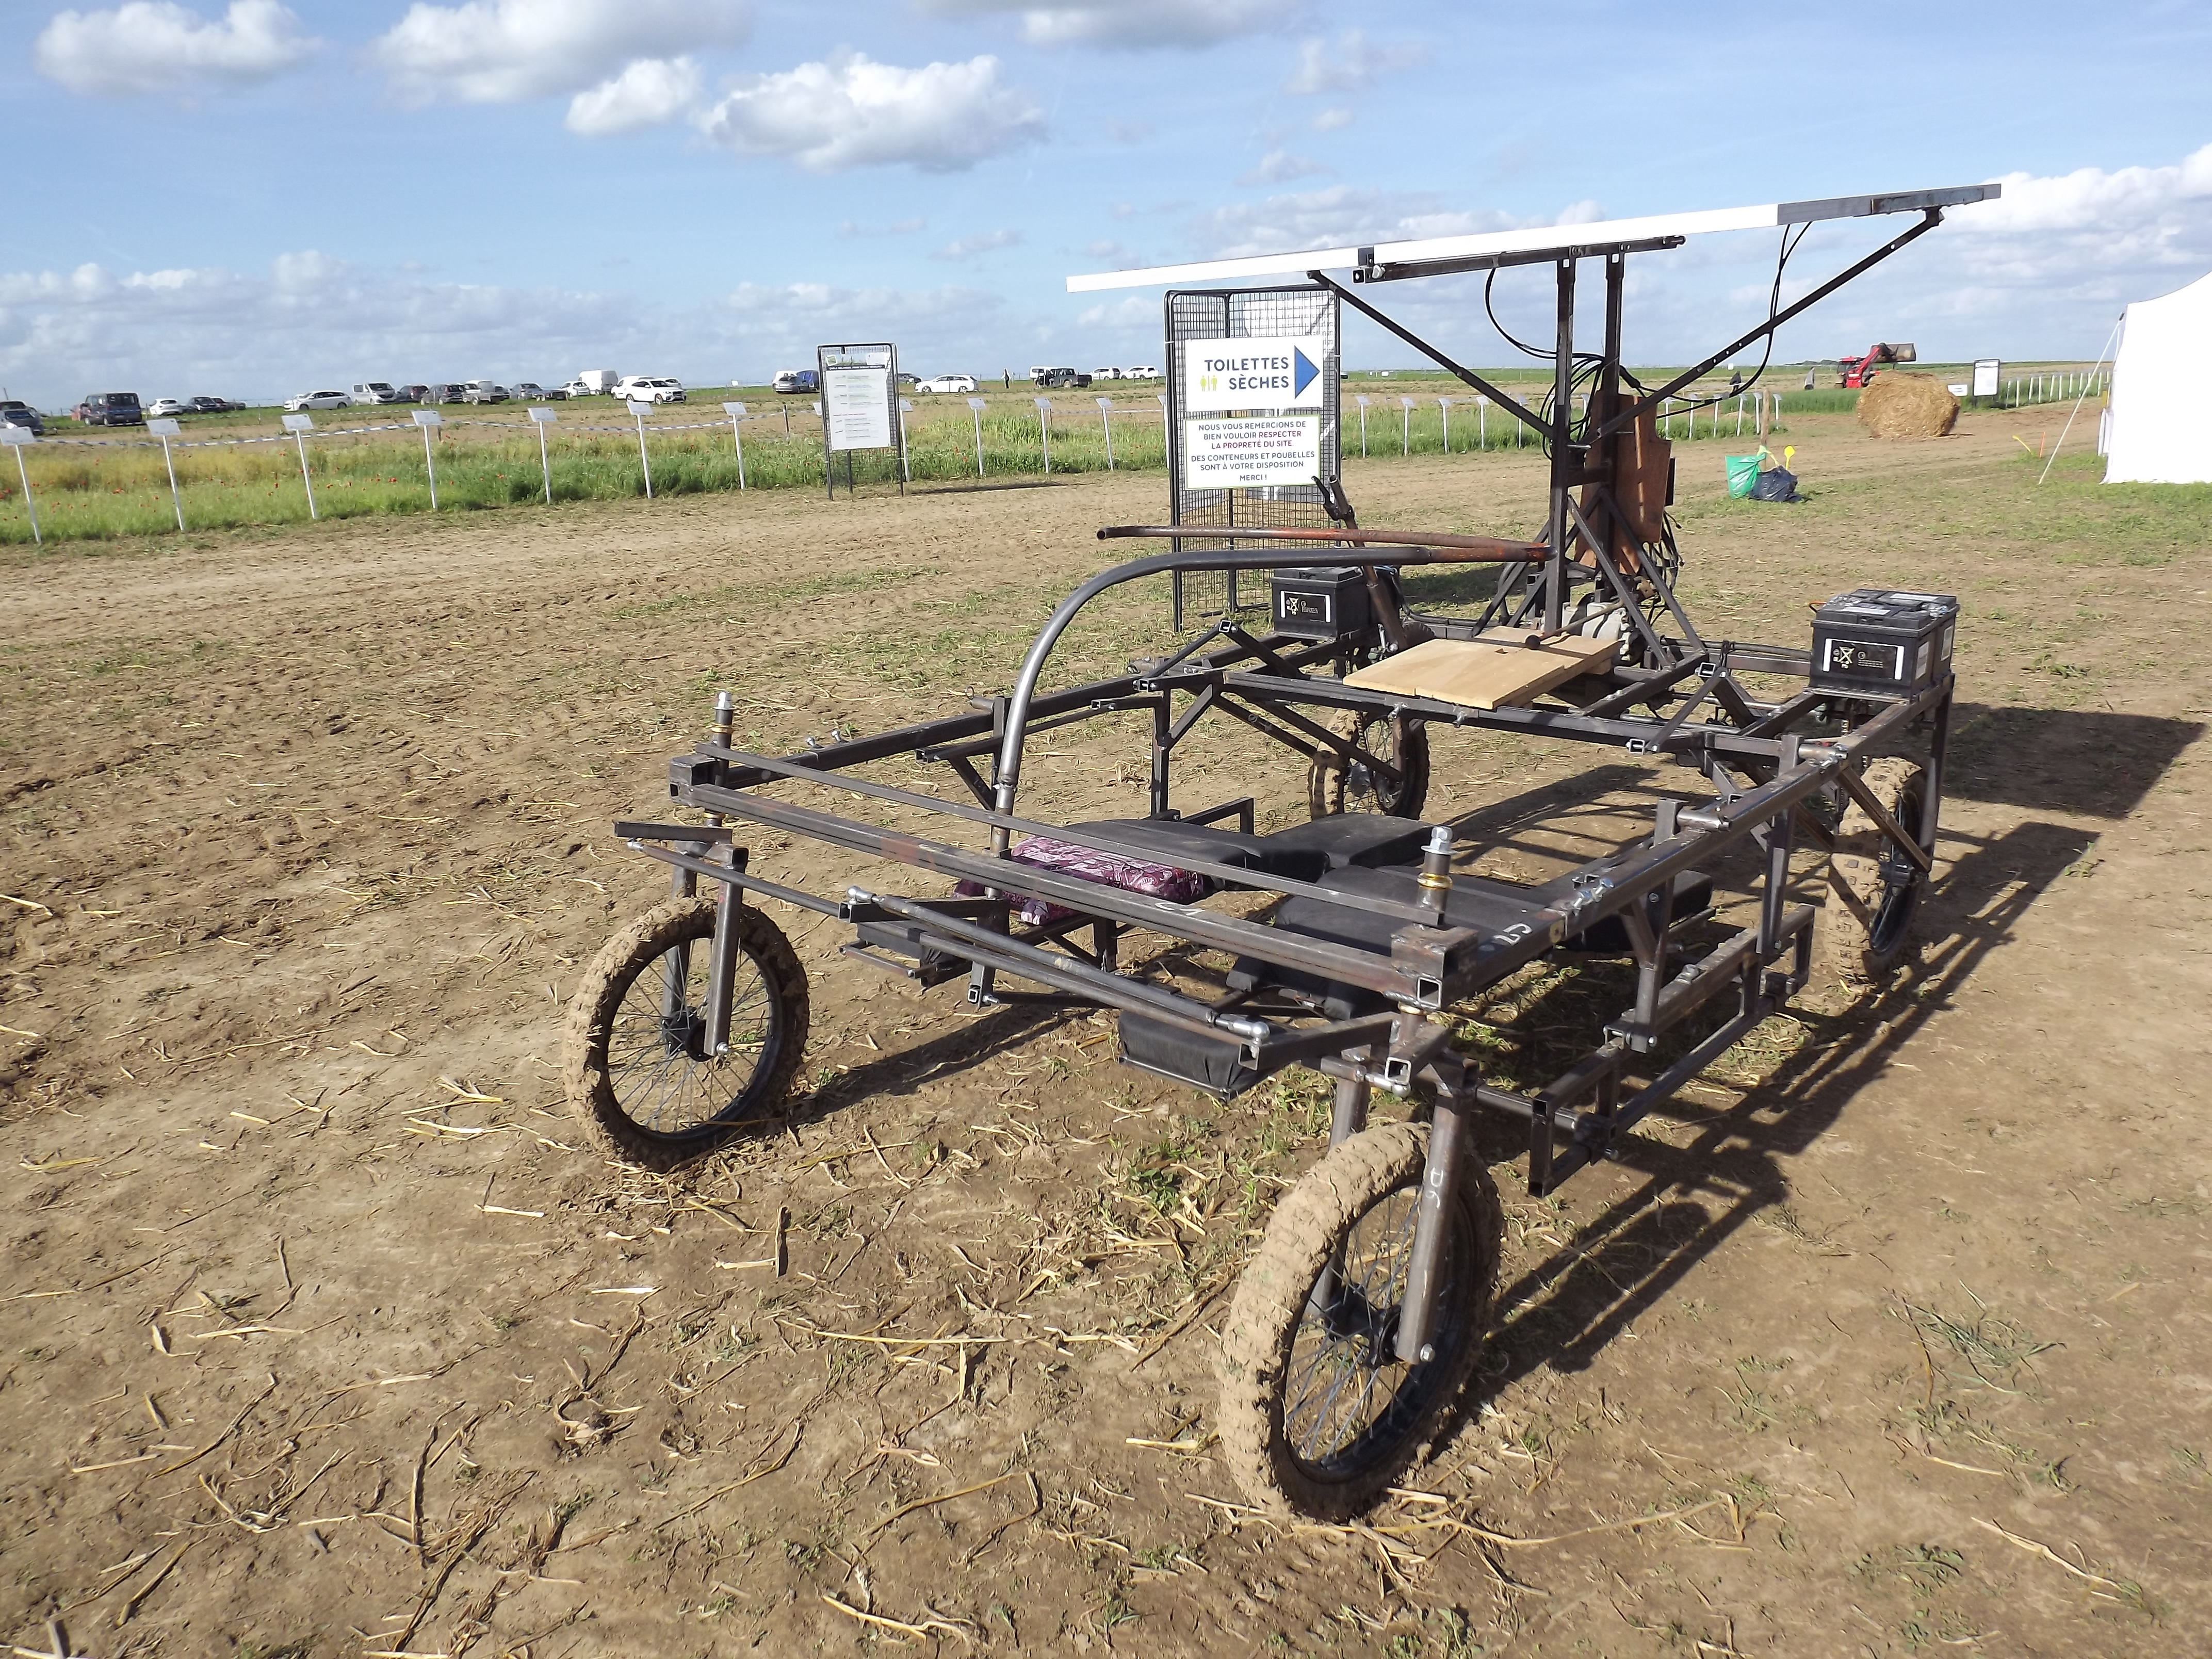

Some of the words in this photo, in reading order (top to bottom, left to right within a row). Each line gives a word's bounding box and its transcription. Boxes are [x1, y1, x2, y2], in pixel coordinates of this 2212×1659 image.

[1204, 357, 1289, 371] TOILETTES
[1229, 373, 1289, 389] SÈCHES
[1245, 421, 1294, 429] REMERCIONS
[1223, 440, 1261, 449] PROPRETÉ
[1207, 453, 1259, 461] CONTENEURS
[1272, 451, 1315, 459] POUBELLES
